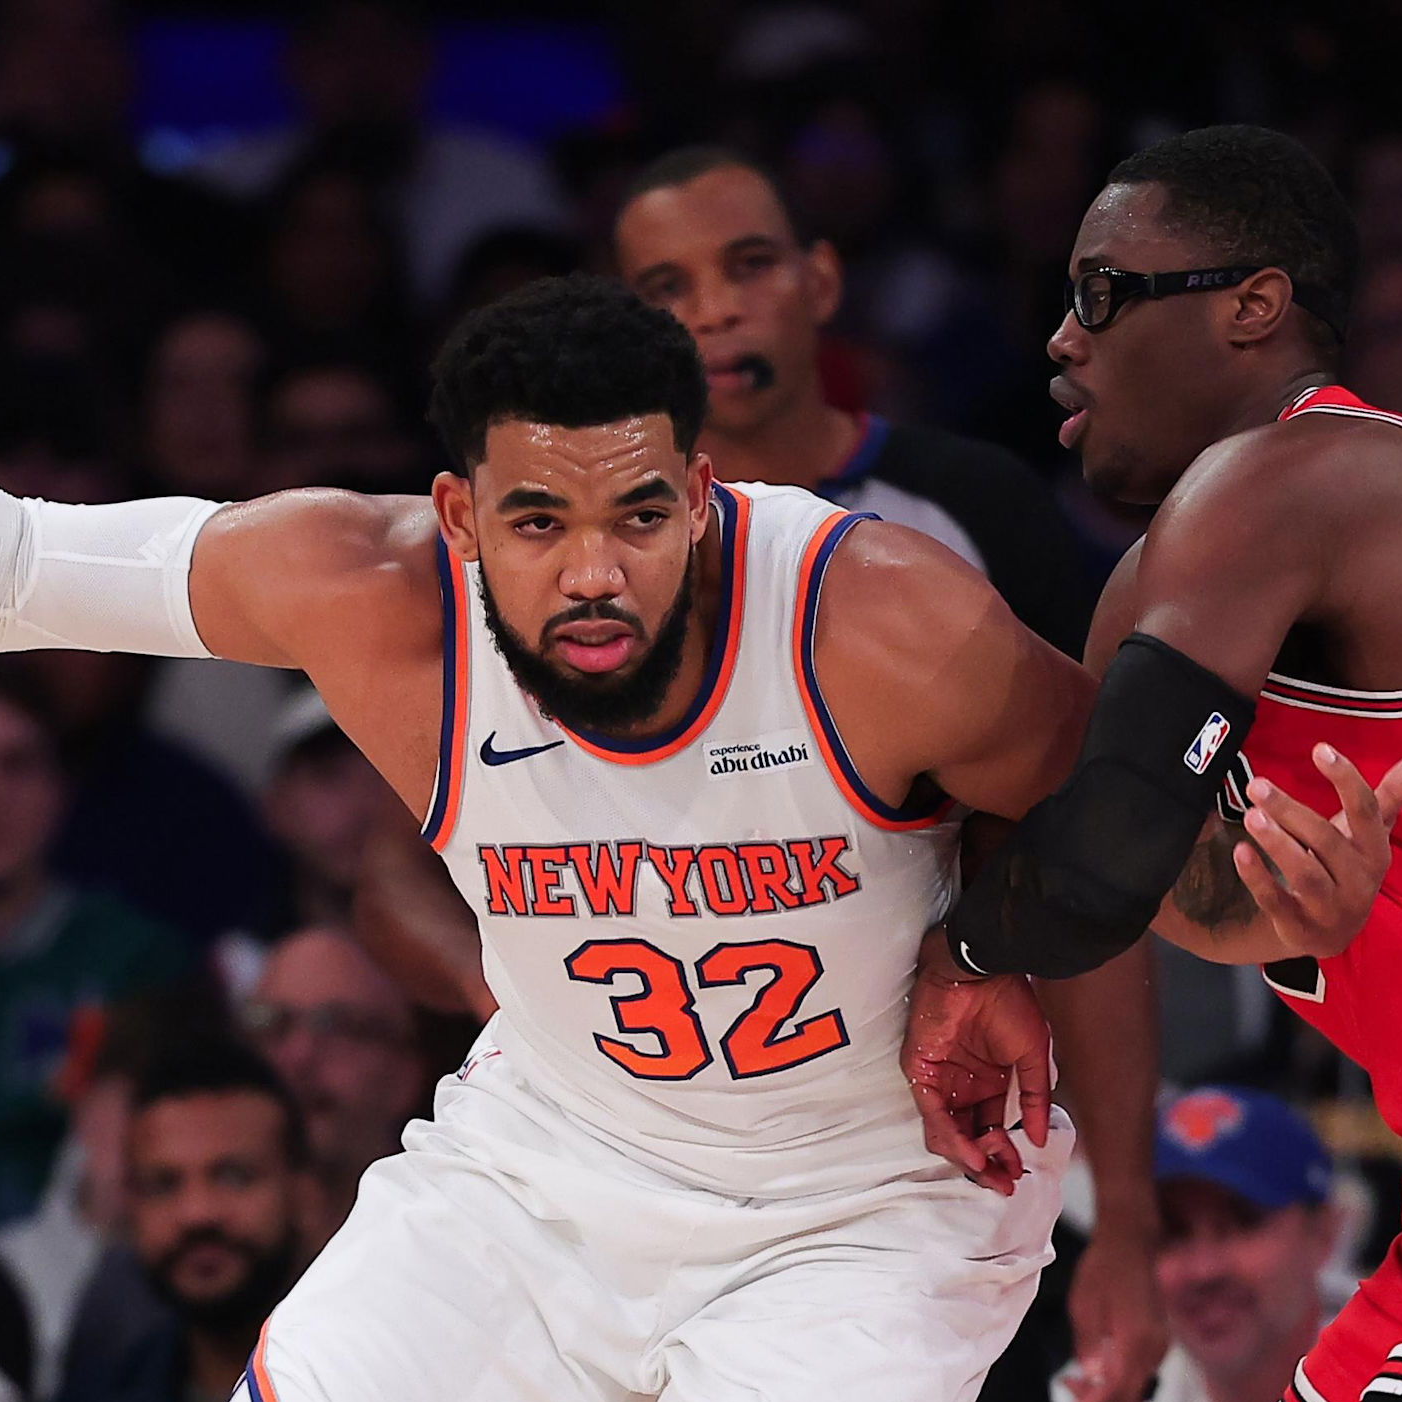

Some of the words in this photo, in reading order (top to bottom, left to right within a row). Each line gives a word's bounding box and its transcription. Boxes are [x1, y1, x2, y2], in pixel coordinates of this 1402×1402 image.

[710, 744, 760, 756] experience
[710, 757, 748, 775] abu
[750, 743, 809, 770] dhabi
[477, 839, 647, 917] NEW
[646, 836, 861, 918] YORK
[564, 938, 850, 1081] 32
